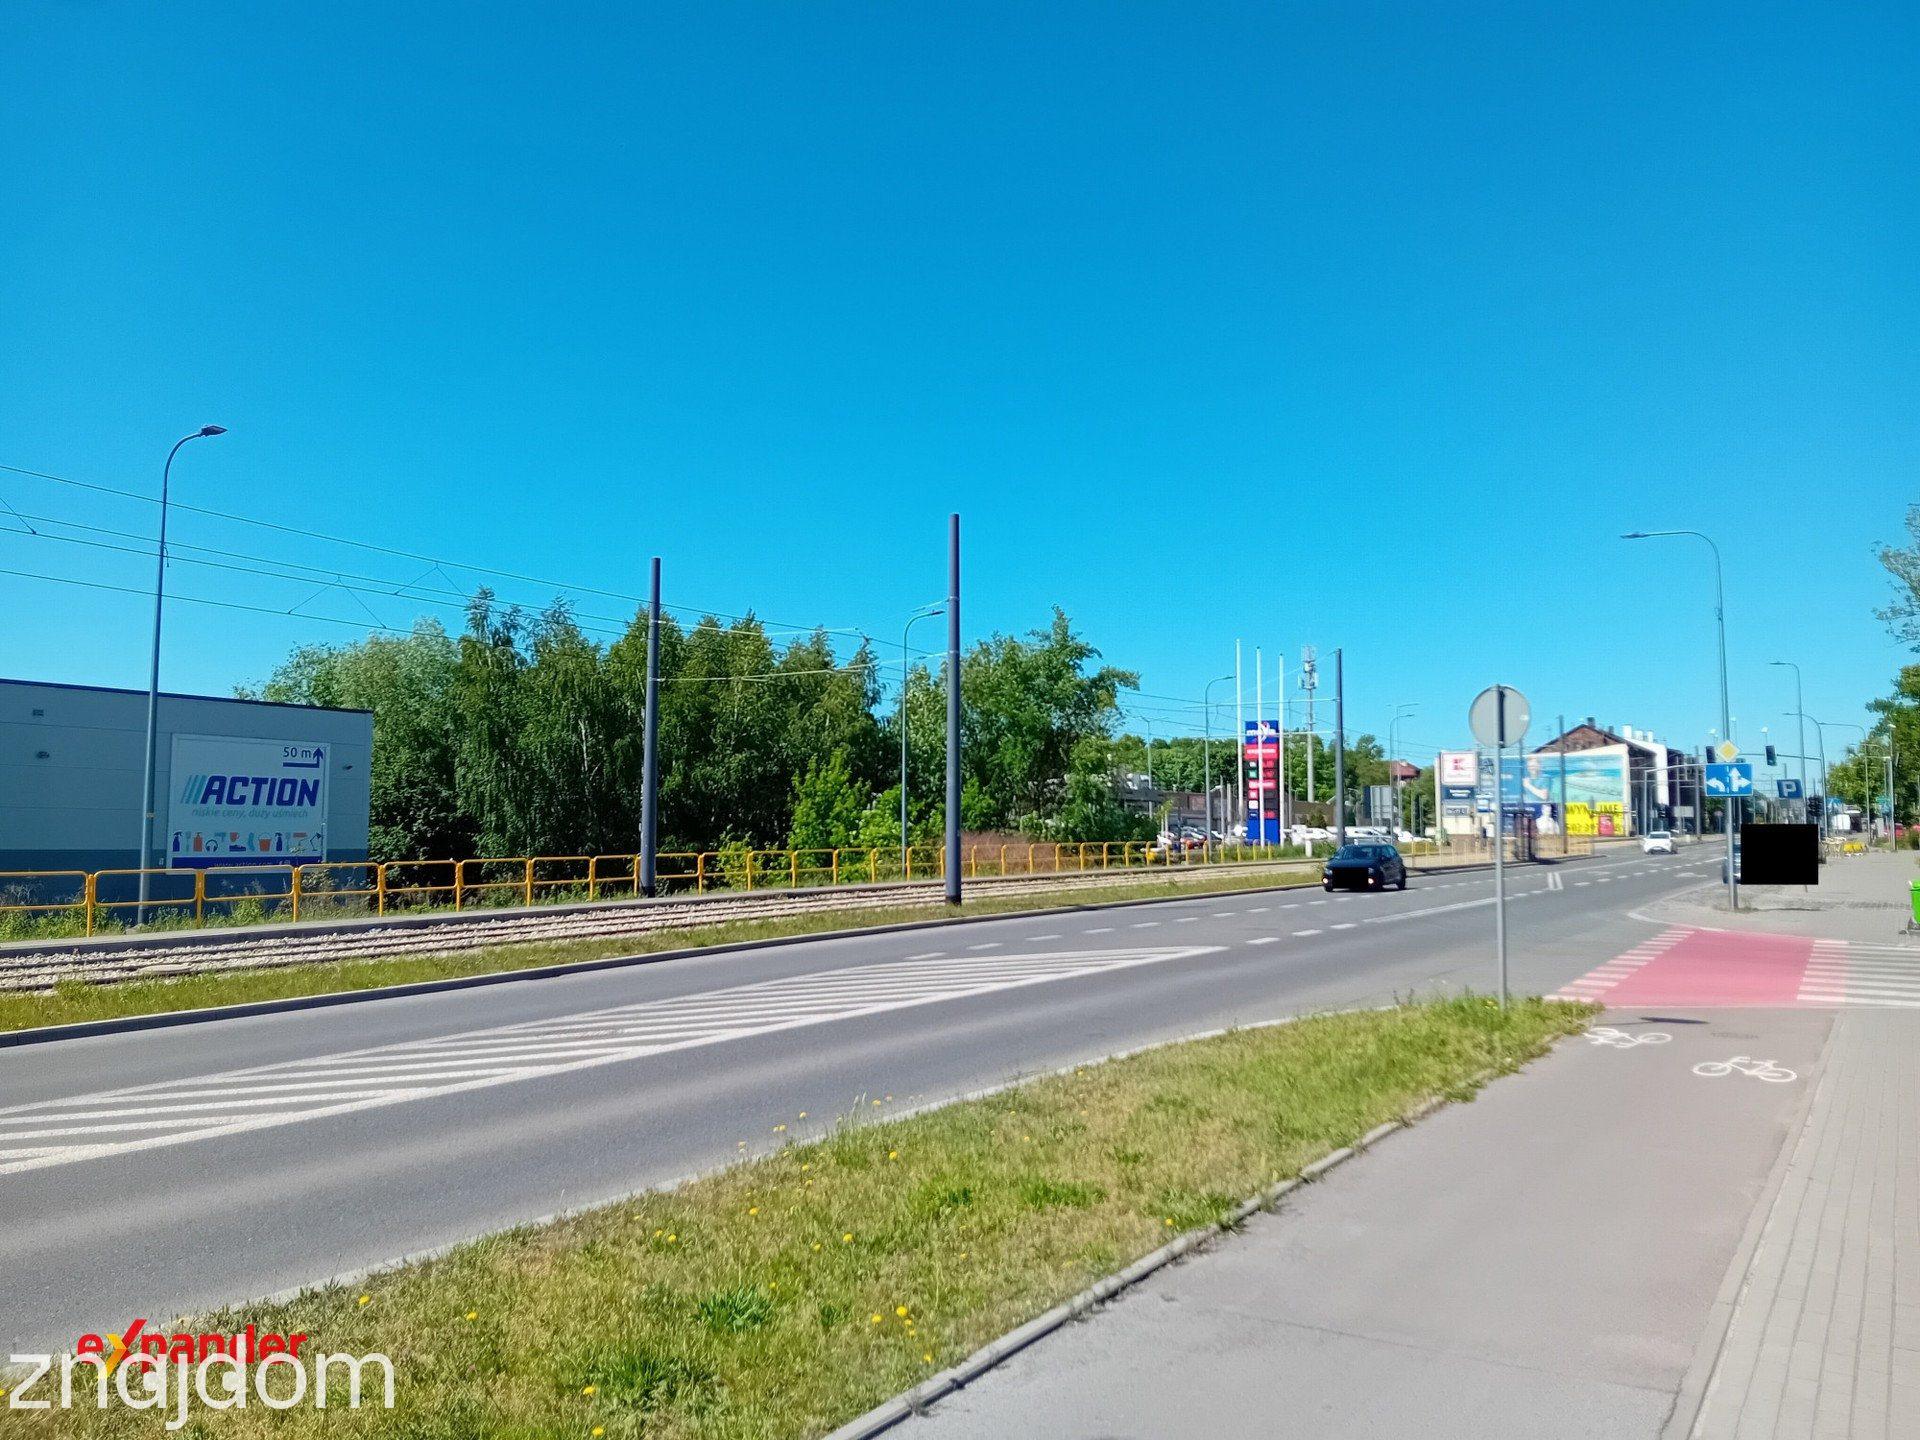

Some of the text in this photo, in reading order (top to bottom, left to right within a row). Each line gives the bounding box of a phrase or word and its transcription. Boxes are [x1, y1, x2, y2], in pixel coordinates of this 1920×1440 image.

[283, 746, 312, 758] 50 m
[200, 775, 320, 807] ACTION
[1782, 780, 1797, 797] P
